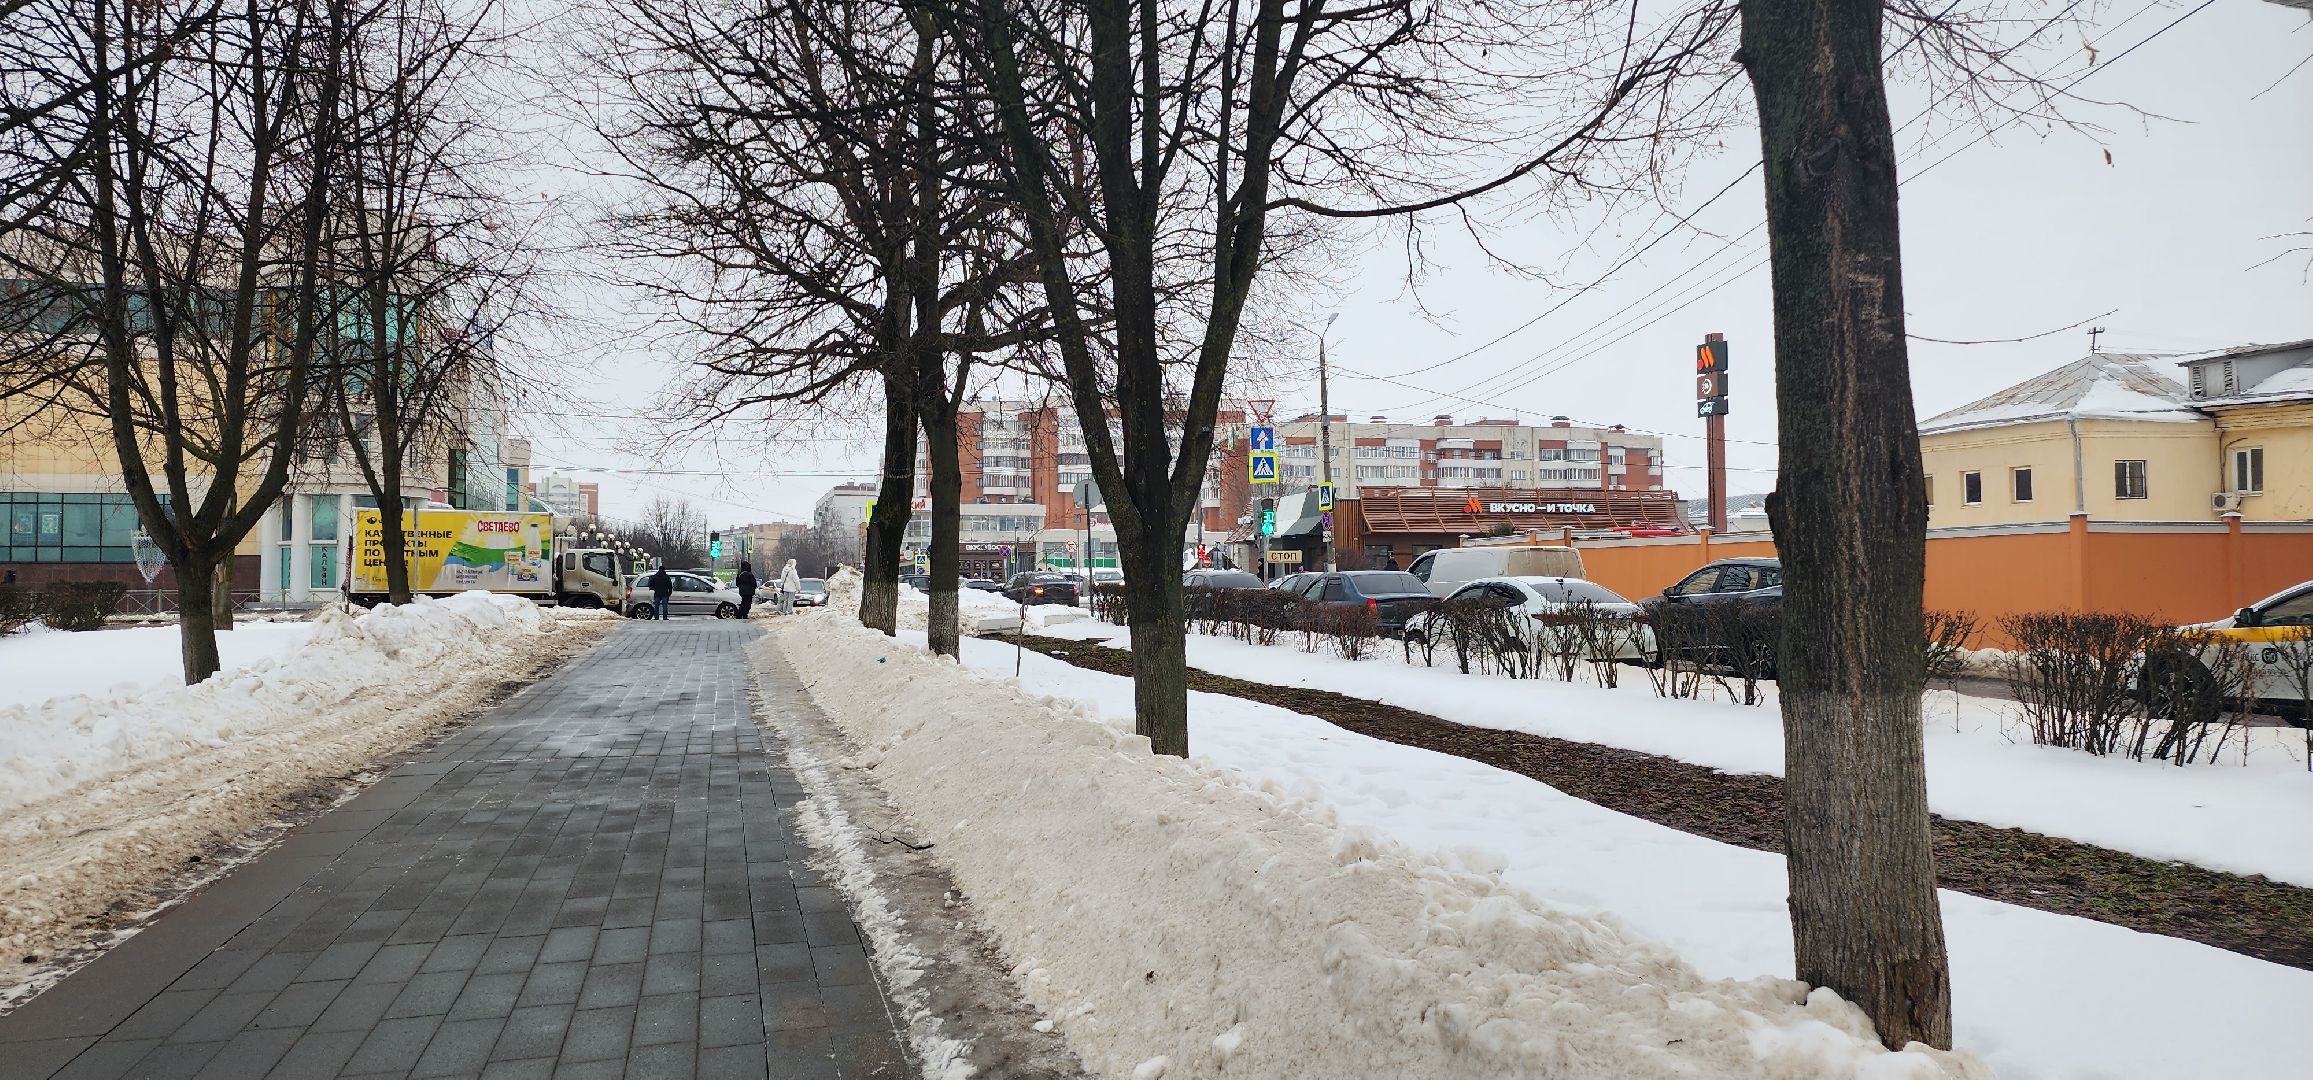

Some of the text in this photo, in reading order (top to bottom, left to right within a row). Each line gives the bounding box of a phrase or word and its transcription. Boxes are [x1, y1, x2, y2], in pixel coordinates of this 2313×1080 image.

[1489, 503, 1536, 513] ВКУСНО
[1557, 504, 1596, 513] ТОЧКА
[477, 520, 520, 533] СВЕТАЕВО
[364, 548, 381, 557] ПО
[1271, 552, 1297, 560] СТОП
